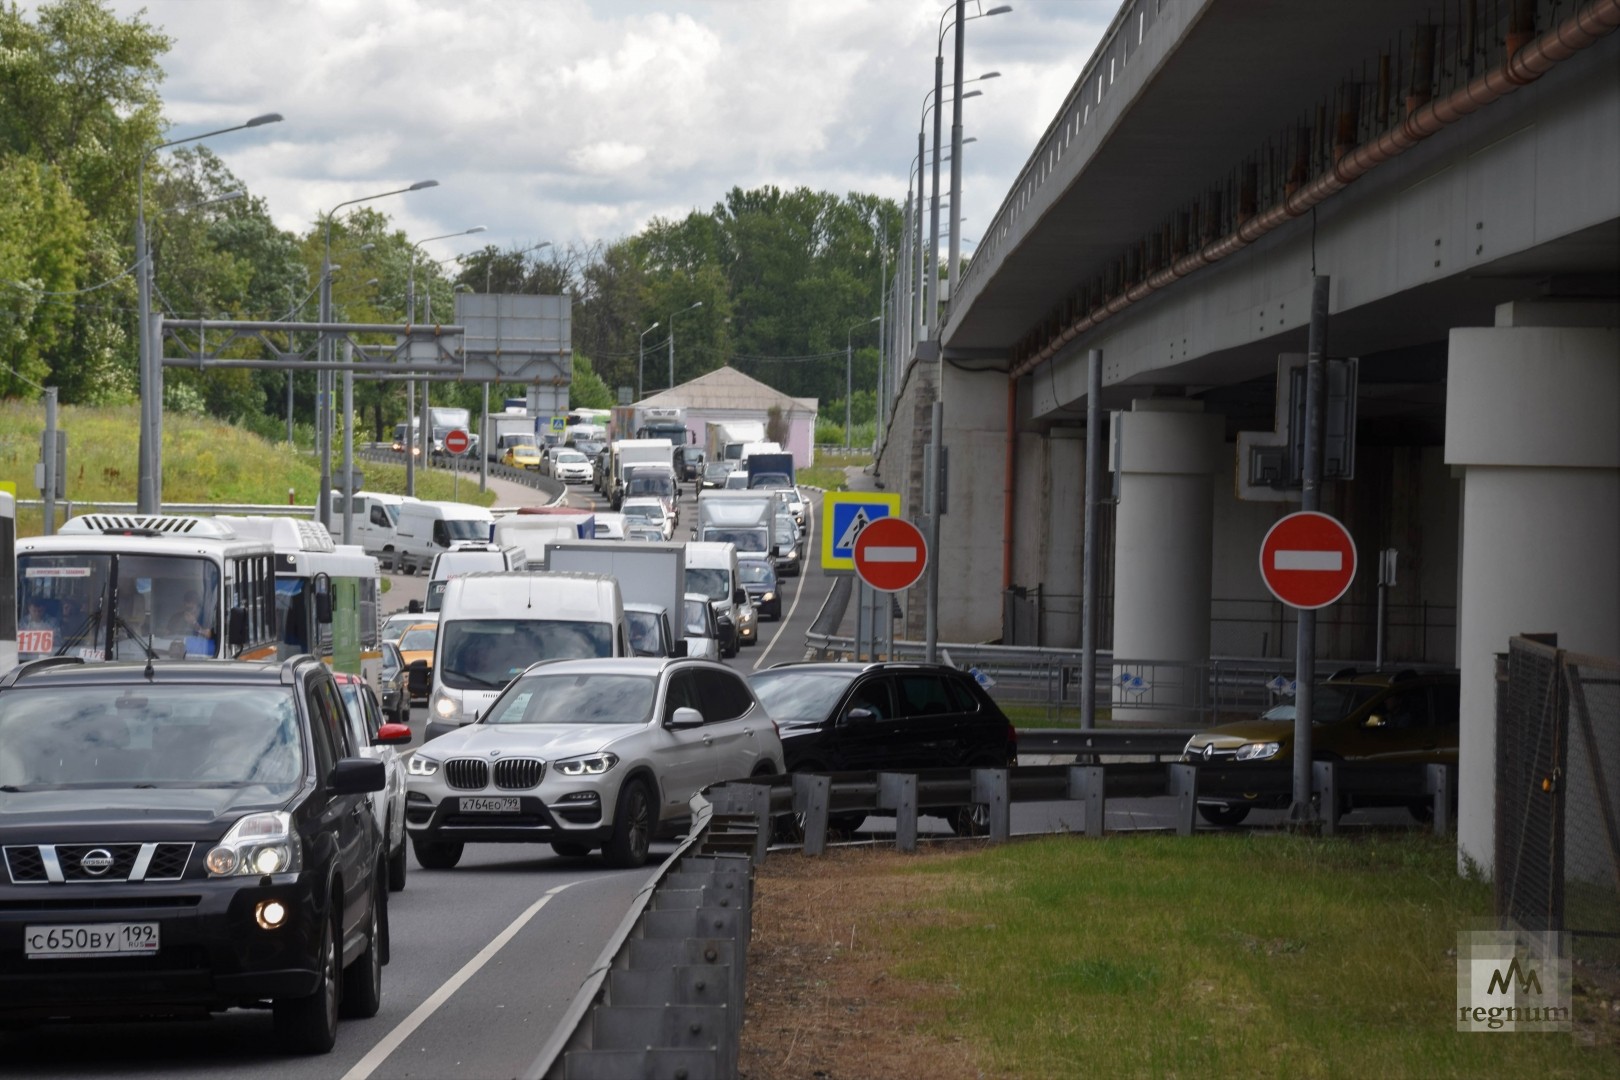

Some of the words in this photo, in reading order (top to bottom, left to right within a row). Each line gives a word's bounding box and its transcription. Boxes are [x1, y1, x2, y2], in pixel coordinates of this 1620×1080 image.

[17, 632, 52, 652] 1176
[82, 858, 113, 866] NISSAN
[122, 926, 153, 941] 199
